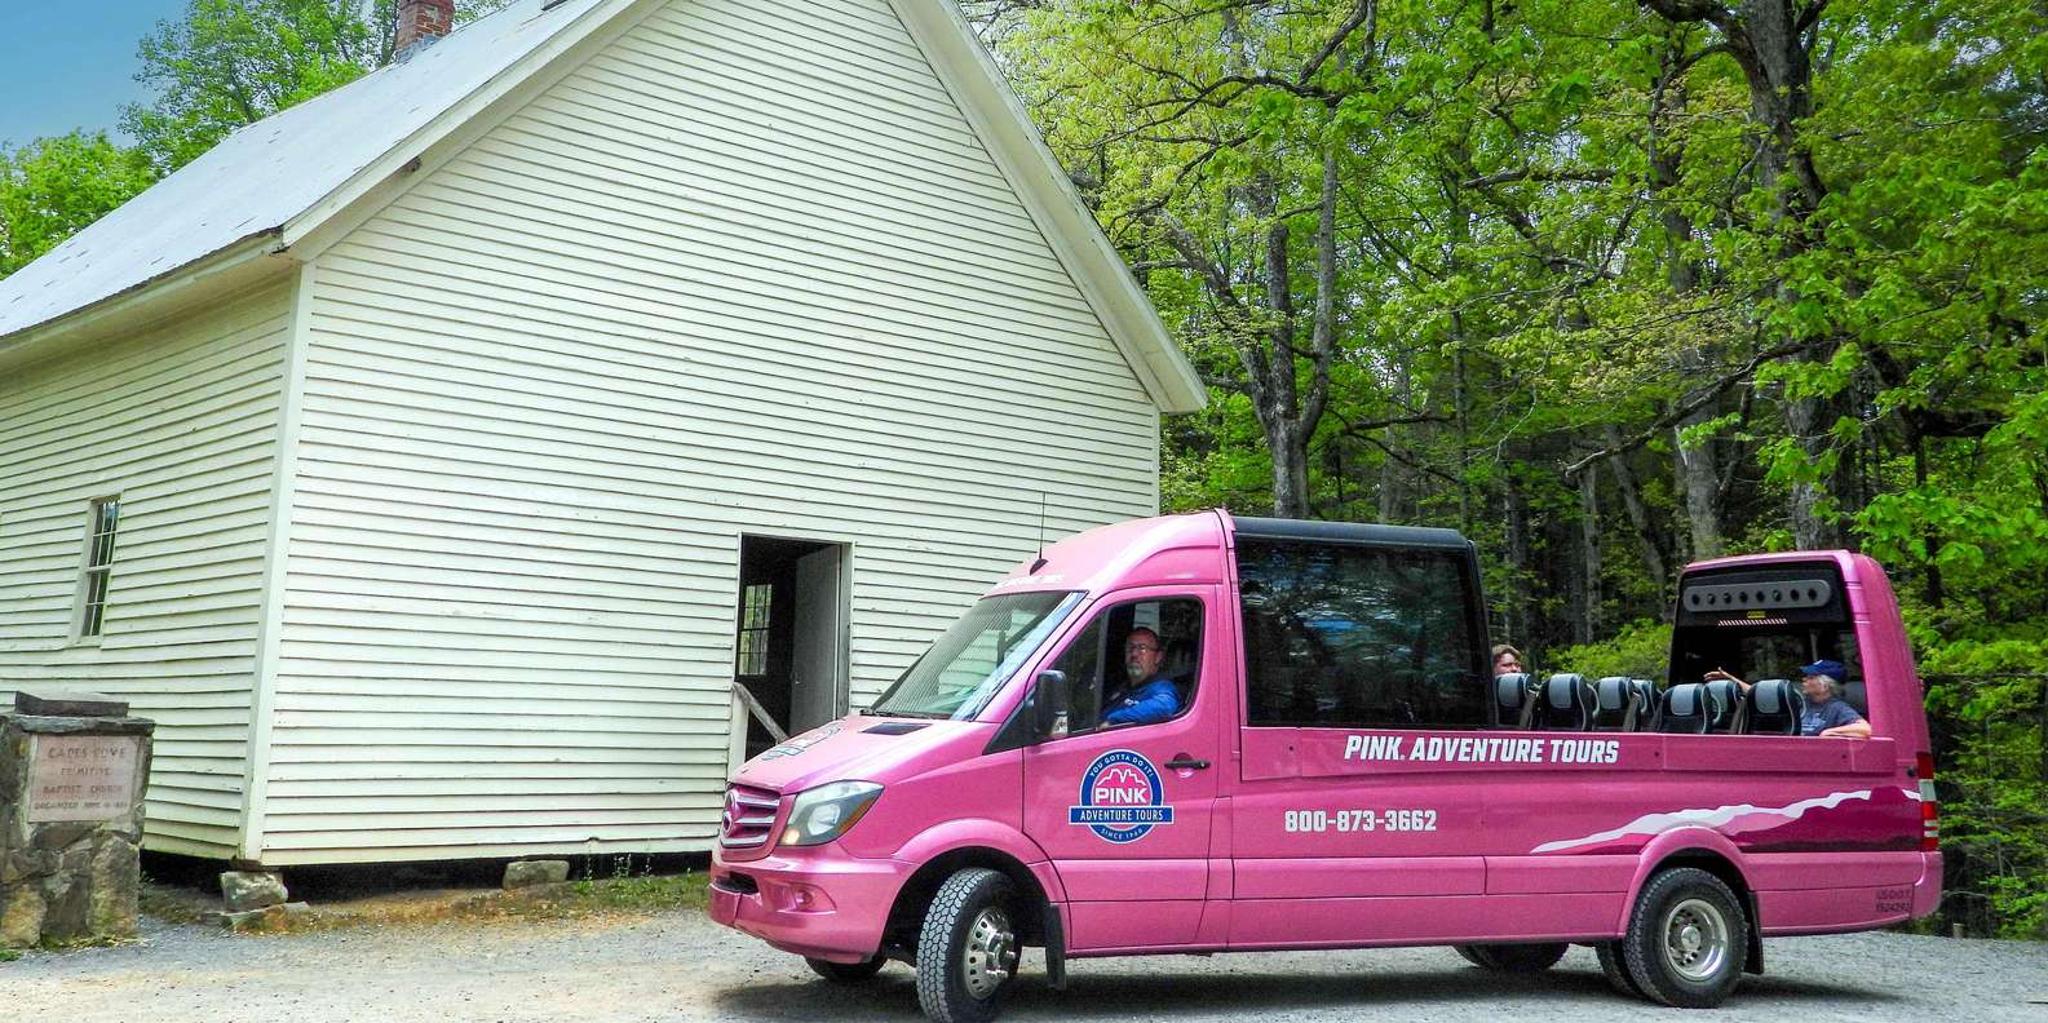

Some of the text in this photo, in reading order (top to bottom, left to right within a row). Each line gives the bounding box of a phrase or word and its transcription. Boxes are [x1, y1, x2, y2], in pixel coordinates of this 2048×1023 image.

[1409, 737, 1545, 763] ADVENTURE
[1550, 739, 1620, 764] TOURS
[1089, 761, 1104, 777] YOU
[1104, 753, 1130, 765] GOTTA
[1132, 756, 1144, 767] DO
[1095, 787, 1148, 804] PINK
[1080, 809, 1164, 821] ADVENTURE TOURS
[1284, 809, 1438, 833] 800-873-3662
[1100, 828, 1123, 841] SINCE
